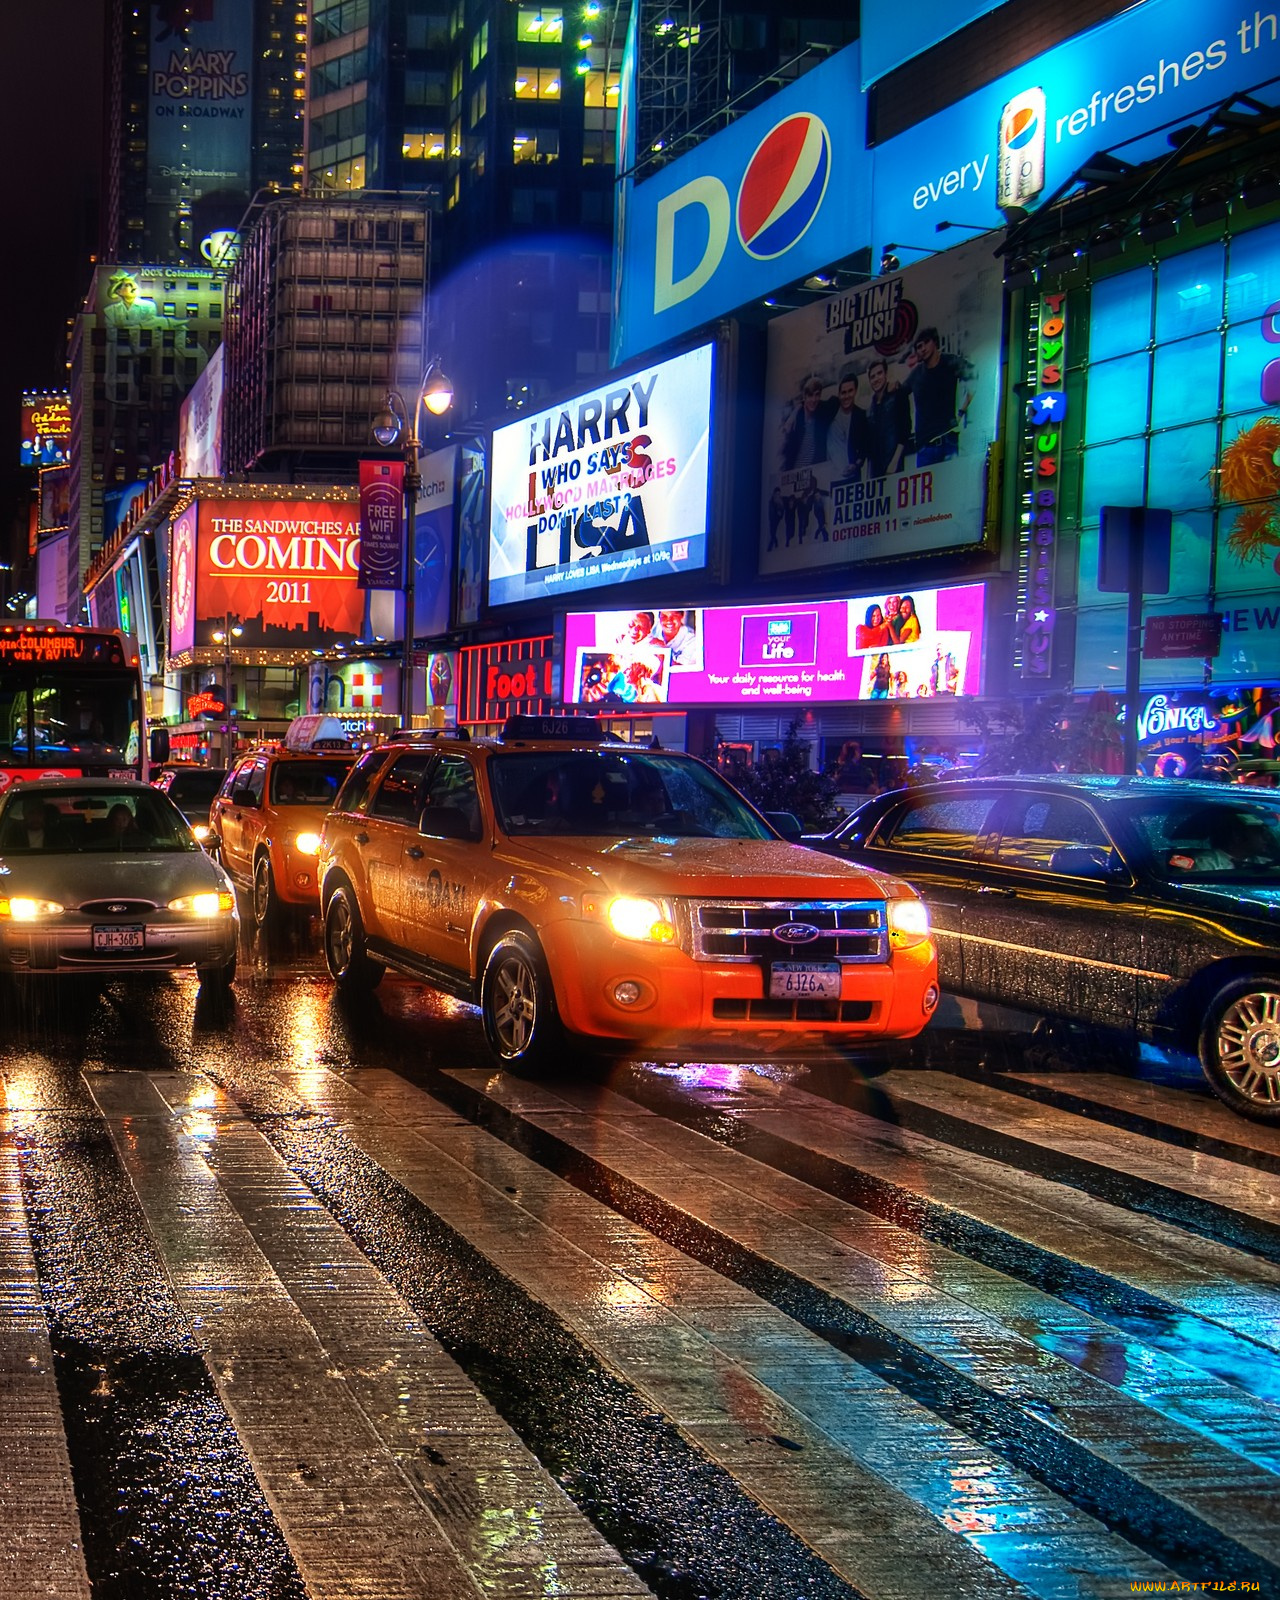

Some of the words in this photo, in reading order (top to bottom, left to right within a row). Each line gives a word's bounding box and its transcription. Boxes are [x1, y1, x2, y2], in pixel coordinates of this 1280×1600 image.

[170, 50, 234, 75] MARY
[152, 72, 249, 99] POPPINS
[1054, 38, 1227, 143] refreshes
[155, 105, 176, 118] ON
[178, 105, 245, 119] BROADWAY
[912, 153, 990, 210] every
[829, 296, 856, 328] BIG
[859, 279, 902, 316] TIME
[851, 310, 895, 349] RUSH
[45, 404, 68, 413] The
[529, 373, 659, 467] HARRY
[541, 459, 581, 490] WHO
[586, 441, 633, 475] SAYS
[506, 487, 582, 521] HOLLYWOOD
[586, 457, 677, 498] MARRIAGES
[834, 477, 887, 506] DEBUT
[897, 471, 933, 509] BTR
[367, 504, 396, 518] FREE
[833, 496, 891, 526] ALBUM
[210, 518, 243, 533] THE
[245, 519, 342, 536] SANDWICHES
[369, 519, 394, 533] WIFI
[538, 507, 579, 534] DON'T
[832, 521, 881, 543] OCTOBER
[885, 518, 897, 532] 11
[266, 581, 311, 603] 2011
[1152, 621, 1165, 631] NO
[1169, 618, 1215, 630] STOPPING
[20, 637, 76, 649] COLUMBUS
[767, 635, 791, 645] your
[1161, 630, 1202, 642] ANYTIME
[36, 650, 43, 660] 7
[45, 649, 61, 660] AV
[761, 642, 795, 659] Life
[487, 664, 537, 699] Foot
[707, 673, 730, 684] Your
[732, 671, 756, 686] daily
[758, 674, 799, 683] resource
[801, 670, 815, 682] for
[817, 669, 845, 681] health
[741, 684, 760, 695] and
[763, 683, 812, 696] well-being
[542, 721, 569, 734] 6J26
[97, 932, 114, 946] CJH
[118, 932, 140, 946] 3685
[787, 928, 809, 939] Ford
